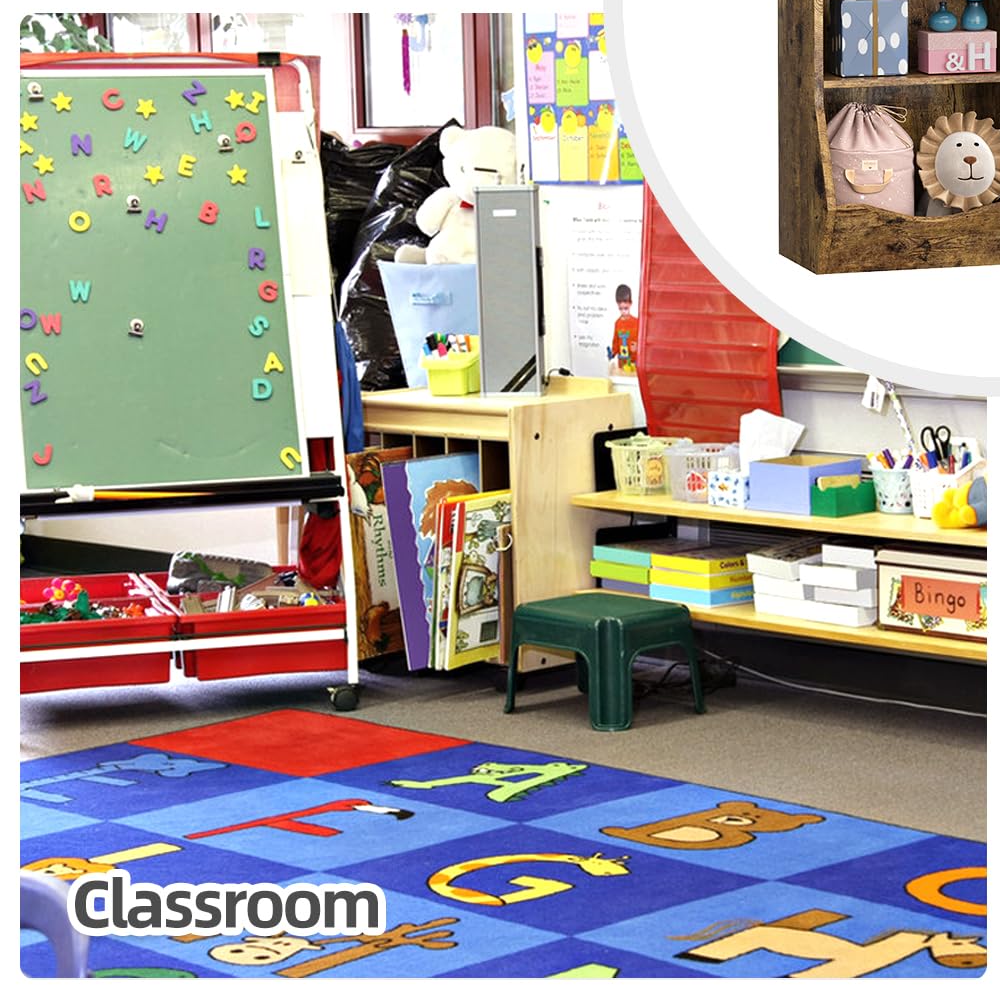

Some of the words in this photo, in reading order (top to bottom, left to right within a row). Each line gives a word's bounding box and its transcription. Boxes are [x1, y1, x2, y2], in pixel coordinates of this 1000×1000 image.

[102, 88, 125, 111] C
[190, 109, 213, 134] H
[71, 133, 93, 156] N
[123, 127, 147, 152] W
[177, 154, 197, 177] E
[22, 179, 47, 204] N
[93, 174, 113, 197] R
[69, 210, 91, 233] O
[144, 208, 168, 233] H
[198, 200, 219, 225] B
[254, 205, 271, 229] L
[248, 248, 266, 270] R
[69, 279, 91, 303] W
[258, 280, 278, 303] G
[248, 315, 270, 337] S
[263, 351, 285, 374] A
[252, 378, 273, 401] D
[33, 443, 53, 466] J
[371, 514, 388, 587] Rhythms
[915, 582, 966, 614] Bingo
